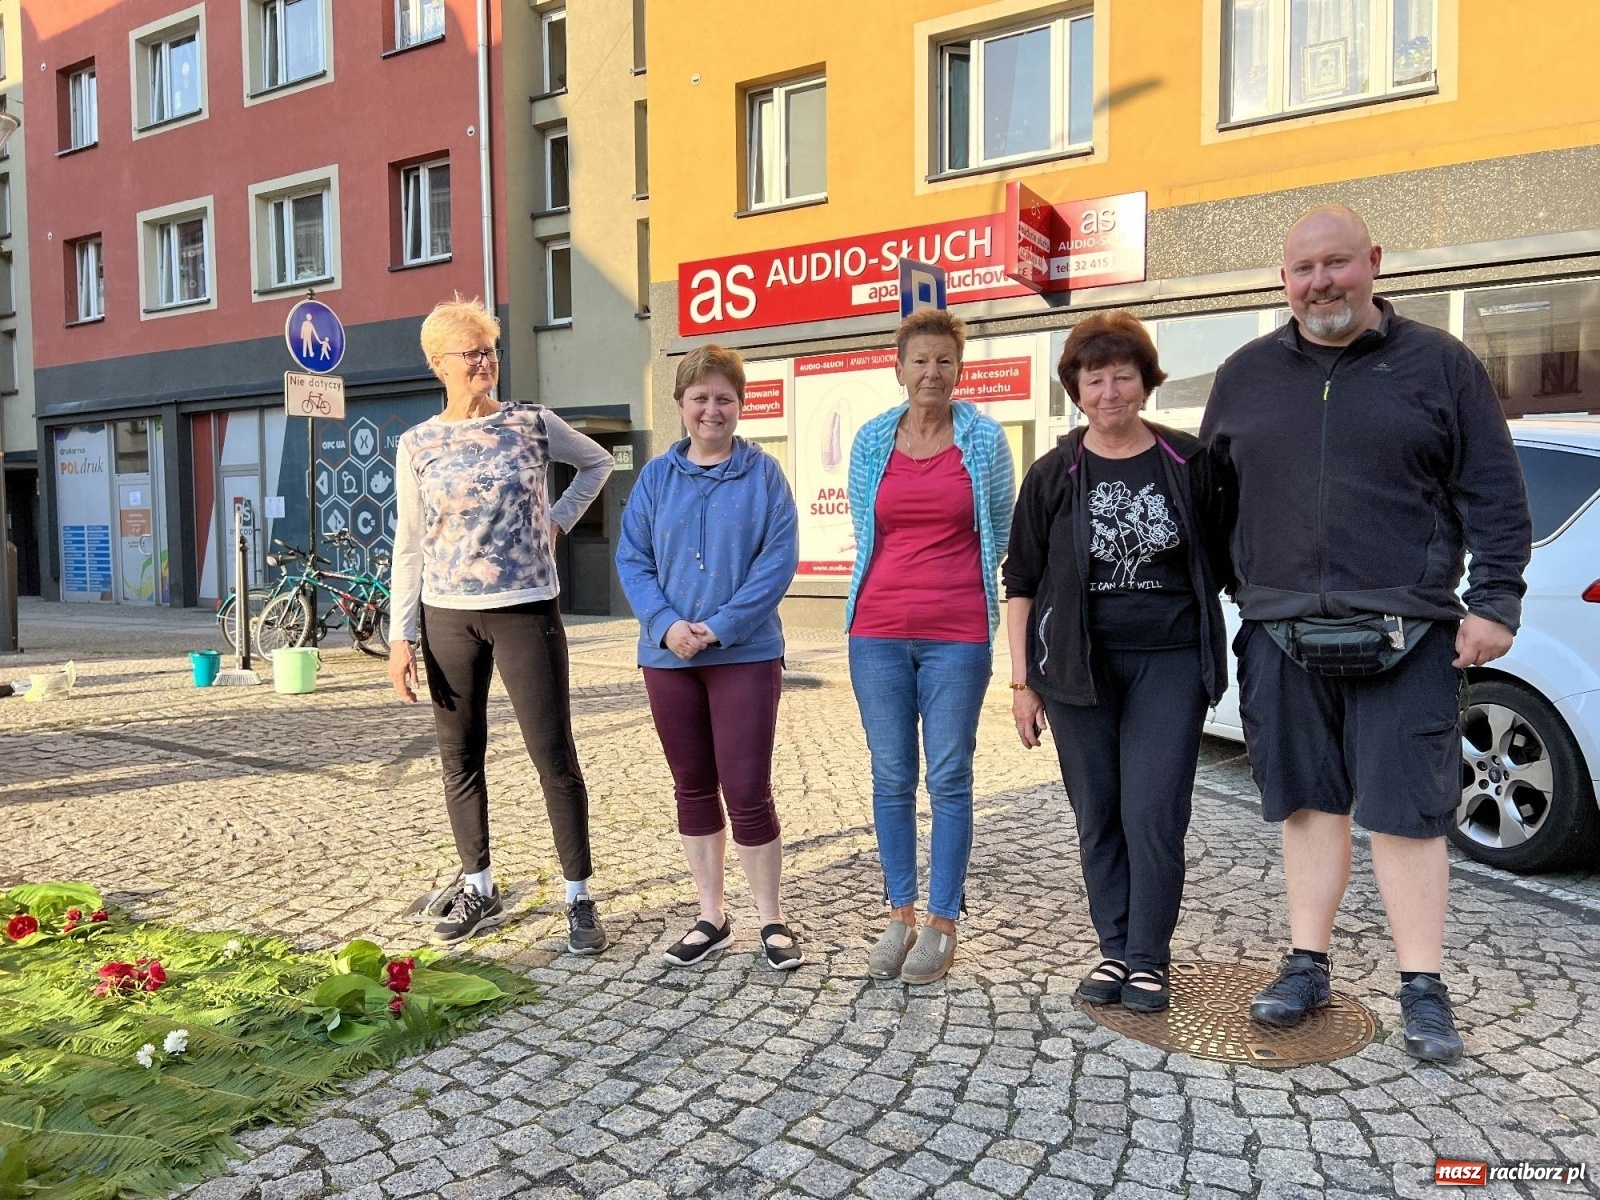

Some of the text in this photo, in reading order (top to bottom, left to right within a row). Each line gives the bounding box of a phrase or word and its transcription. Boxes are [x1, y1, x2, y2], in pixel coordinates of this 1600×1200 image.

[1080, 207, 1116, 235] as
[766, 226, 992, 288] AUDIO-SŁUCH
[1074, 260, 1087, 271] 32
[1090, 257, 1109, 268] 415
[689, 264, 757, 324] as
[868, 284, 898, 302] apa
[800, 361, 844, 371] AUDIO-SŁUCH
[850, 357, 871, 366] APARATY
[971, 367, 1019, 380] akcesoria
[289, 375, 342, 391] Nie dotyczy
[977, 383, 1011, 394] słuchu
[744, 388, 780, 399] stowanie
[322, 440, 346, 450] OPC UA
[384, 435, 400, 449] .NE
[616, 451, 629, 463] 46
[818, 488, 849, 500] APA
[810, 502, 851, 515] SŁUCH
[1090, 582, 1096, 591] I
[1098, 581, 1116, 590] CAN
[1127, 581, 1135, 589] I
[1137, 580, 1163, 590] WILL
